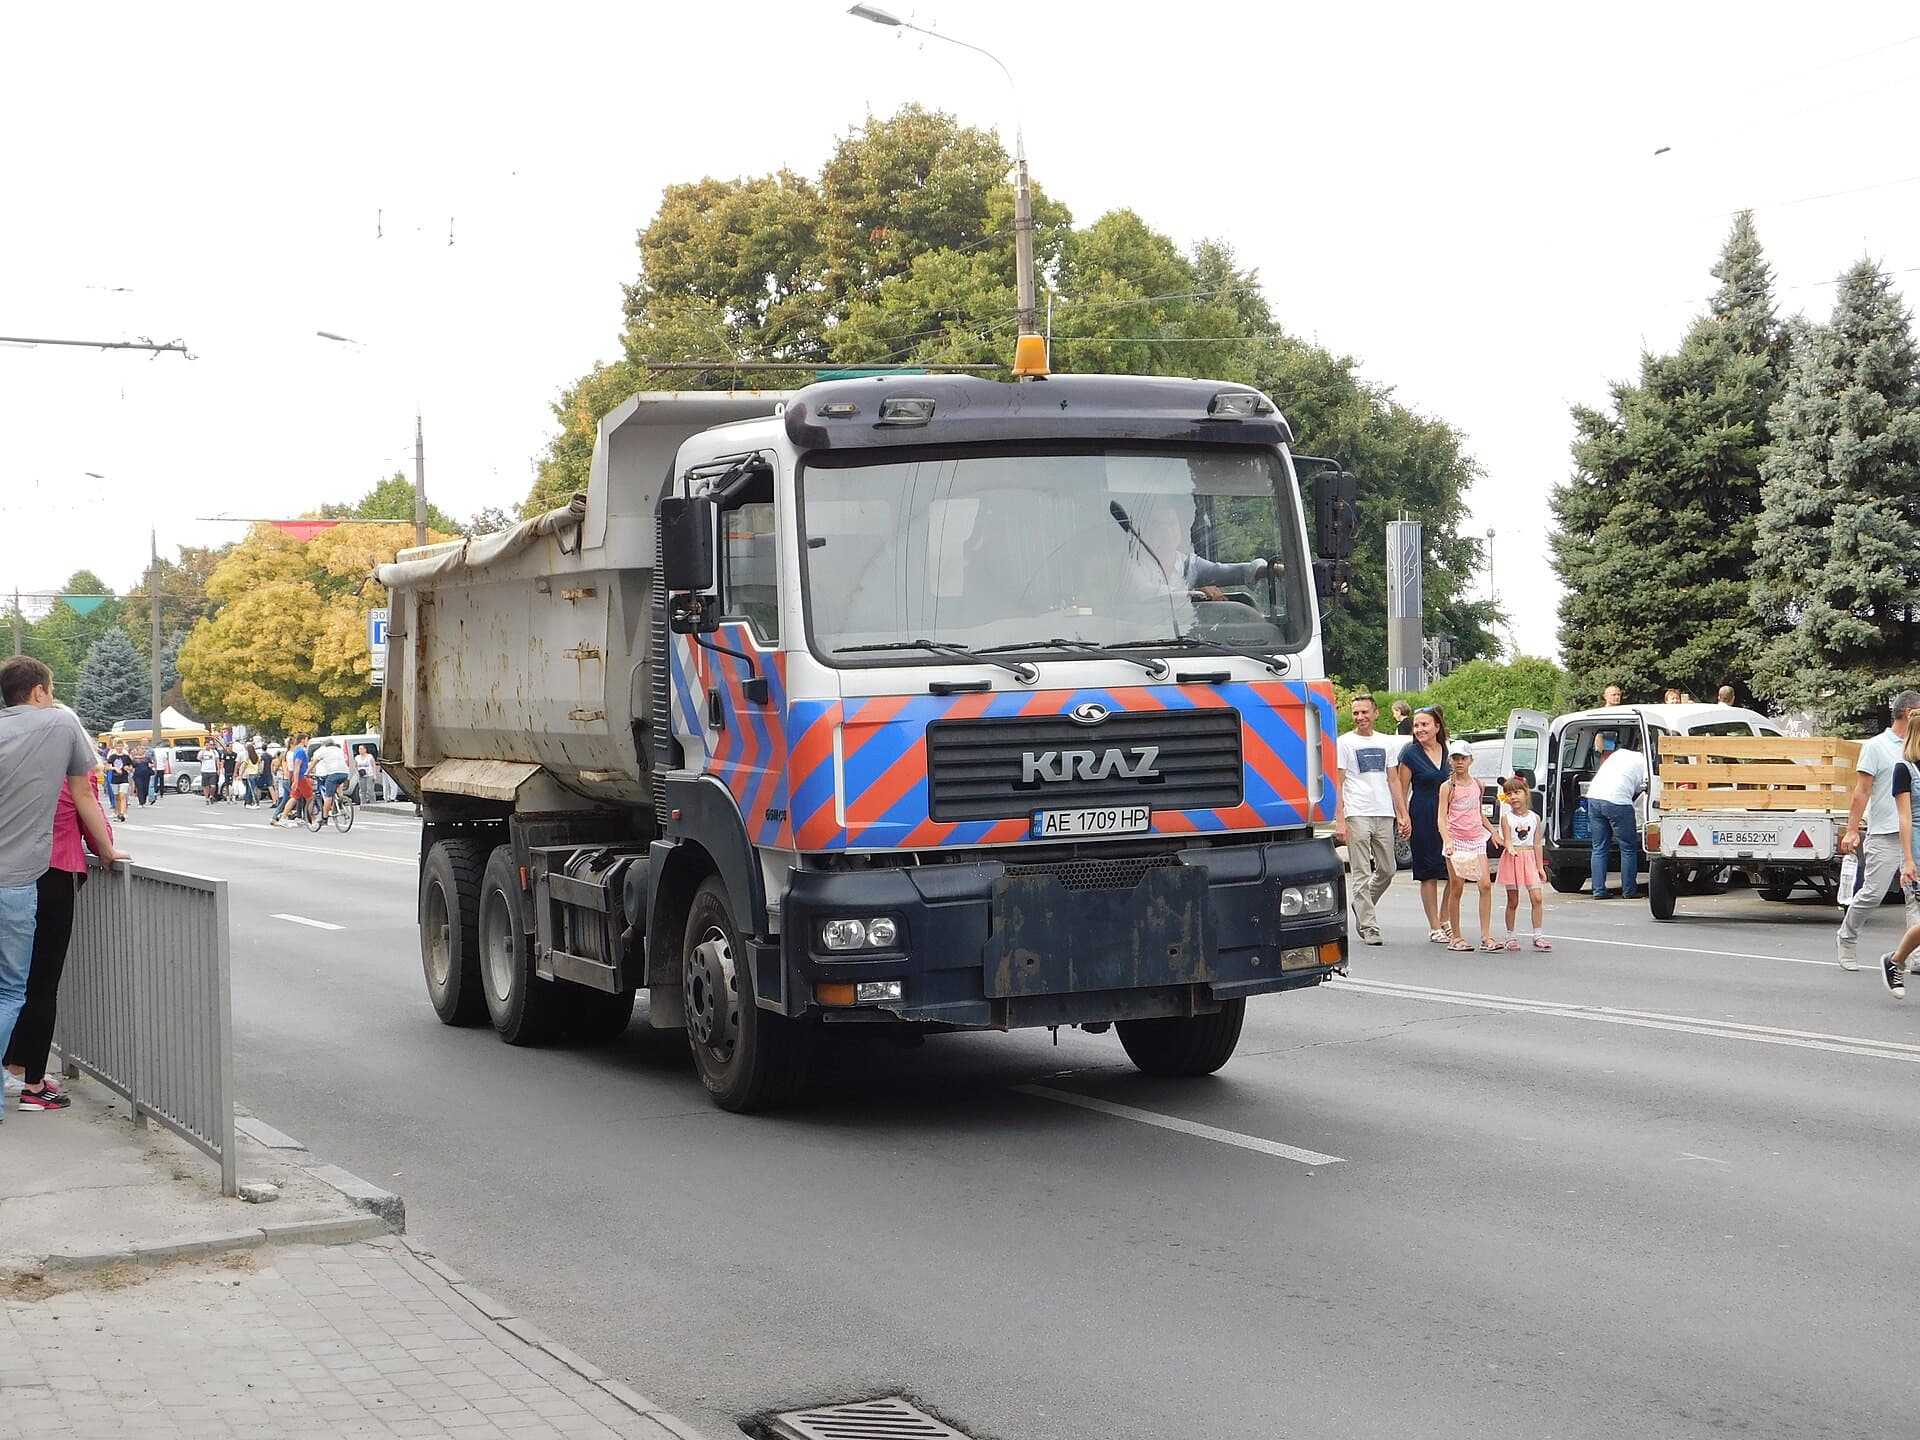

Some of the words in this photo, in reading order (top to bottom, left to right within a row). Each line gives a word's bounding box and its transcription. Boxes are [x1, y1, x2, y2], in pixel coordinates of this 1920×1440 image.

[1022, 746, 1160, 783] KRAZ
[1045, 813, 1071, 833] AE
[1077, 811, 1117, 831] 1709
[1121, 809, 1147, 828] HP
[1719, 832, 1733, 843] AE
[1735, 832, 1759, 843] 8652
[1761, 832, 1776, 843] XM
